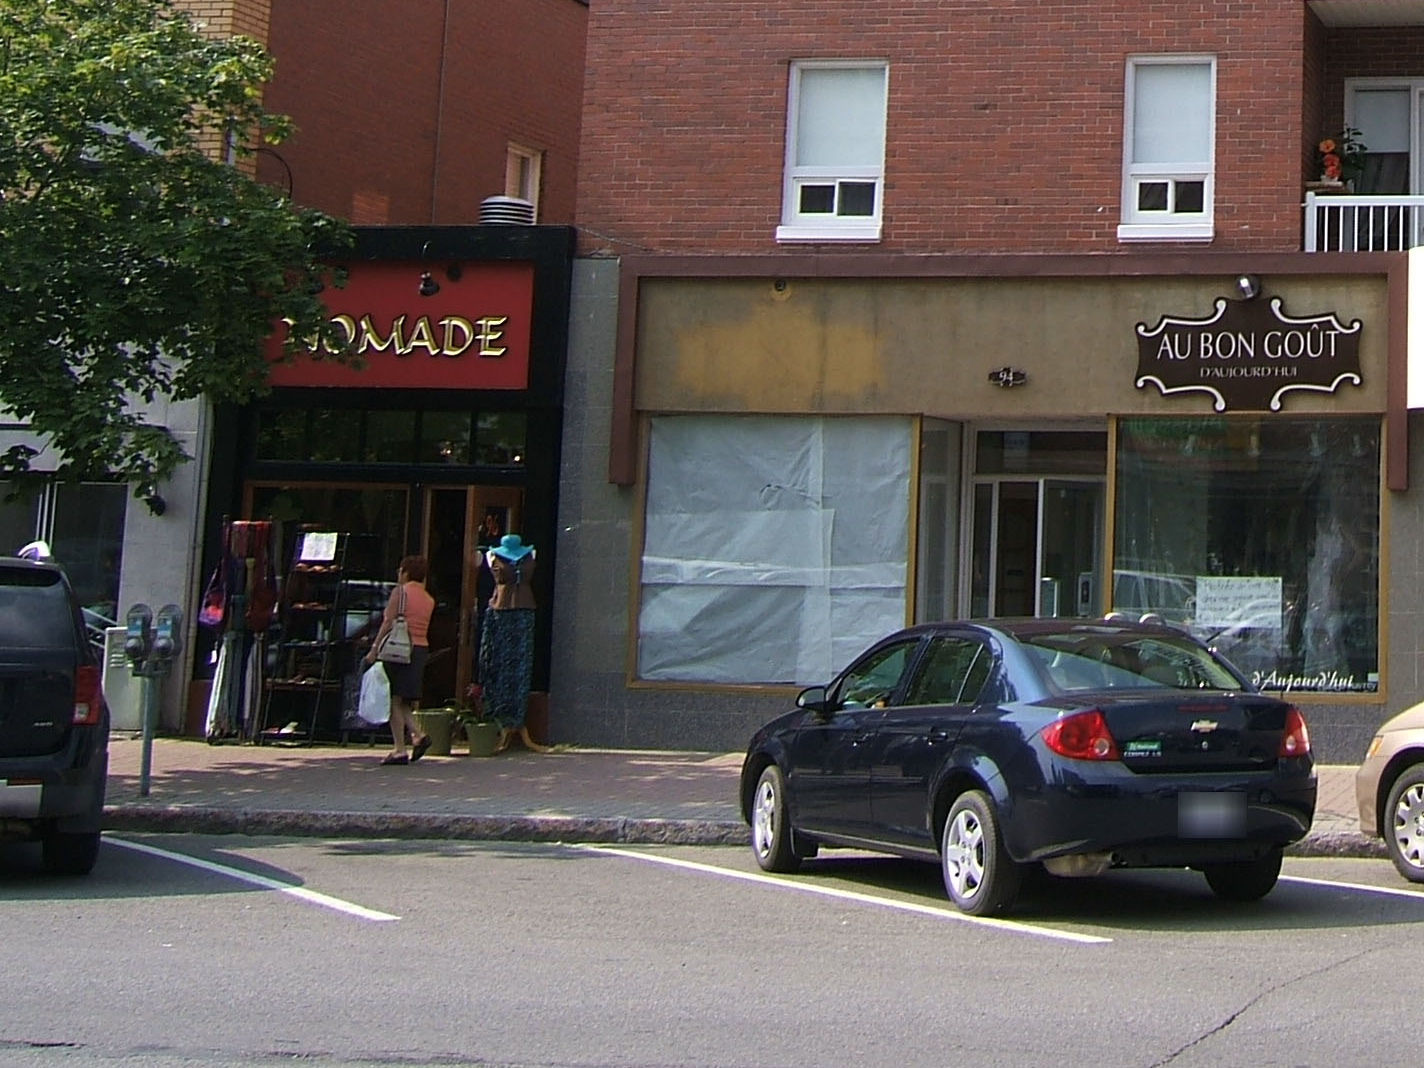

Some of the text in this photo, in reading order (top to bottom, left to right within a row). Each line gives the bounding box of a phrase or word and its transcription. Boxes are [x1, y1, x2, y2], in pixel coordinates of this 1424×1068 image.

[1157, 323, 1341, 360] AU BON GOÛT
[999, 371, 1013, 381] 94
[1200, 366, 1298, 378] D'AUJOURD'HUI
